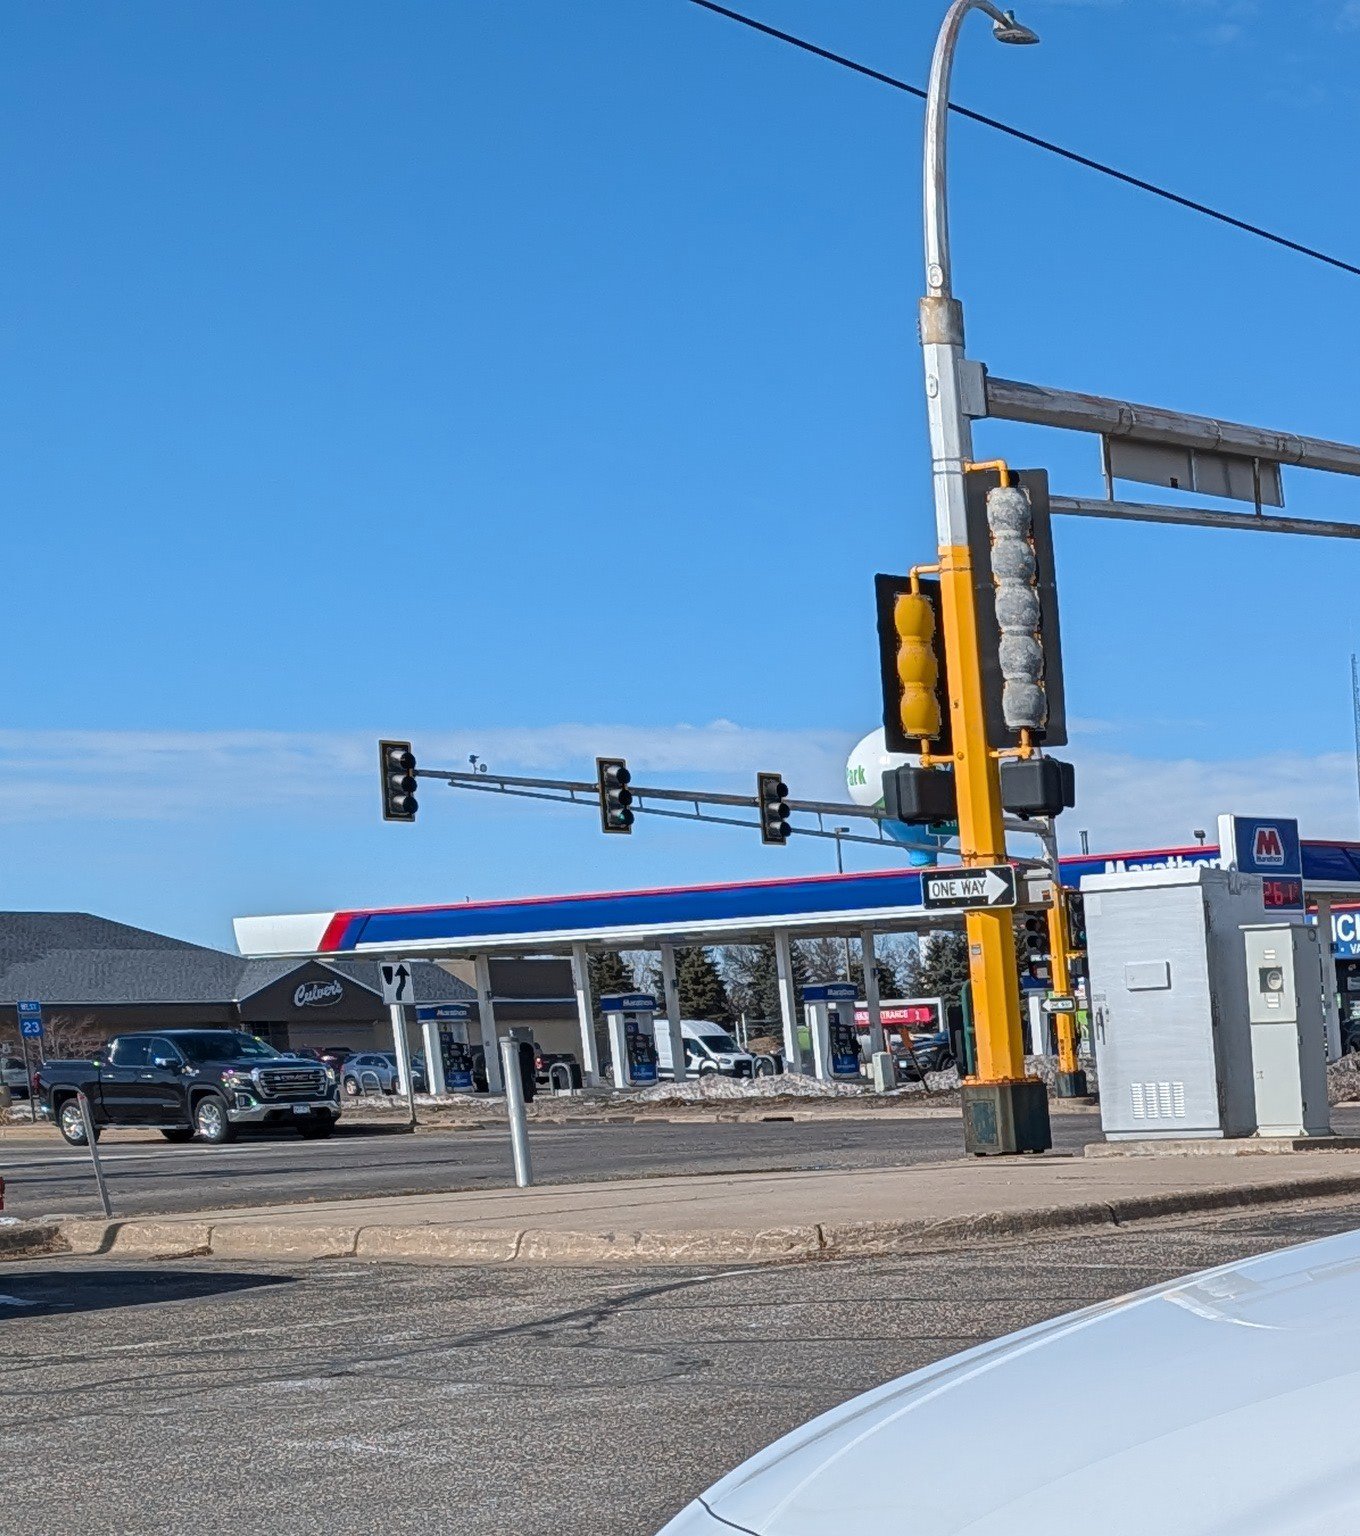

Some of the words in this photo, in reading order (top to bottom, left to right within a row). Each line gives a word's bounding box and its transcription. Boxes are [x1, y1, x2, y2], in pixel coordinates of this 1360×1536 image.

[932, 880, 957, 897] ONE
[961, 879, 986, 896] WAY
[294, 980, 343, 1007] Culver's
[23, 1021, 40, 1033] 23
